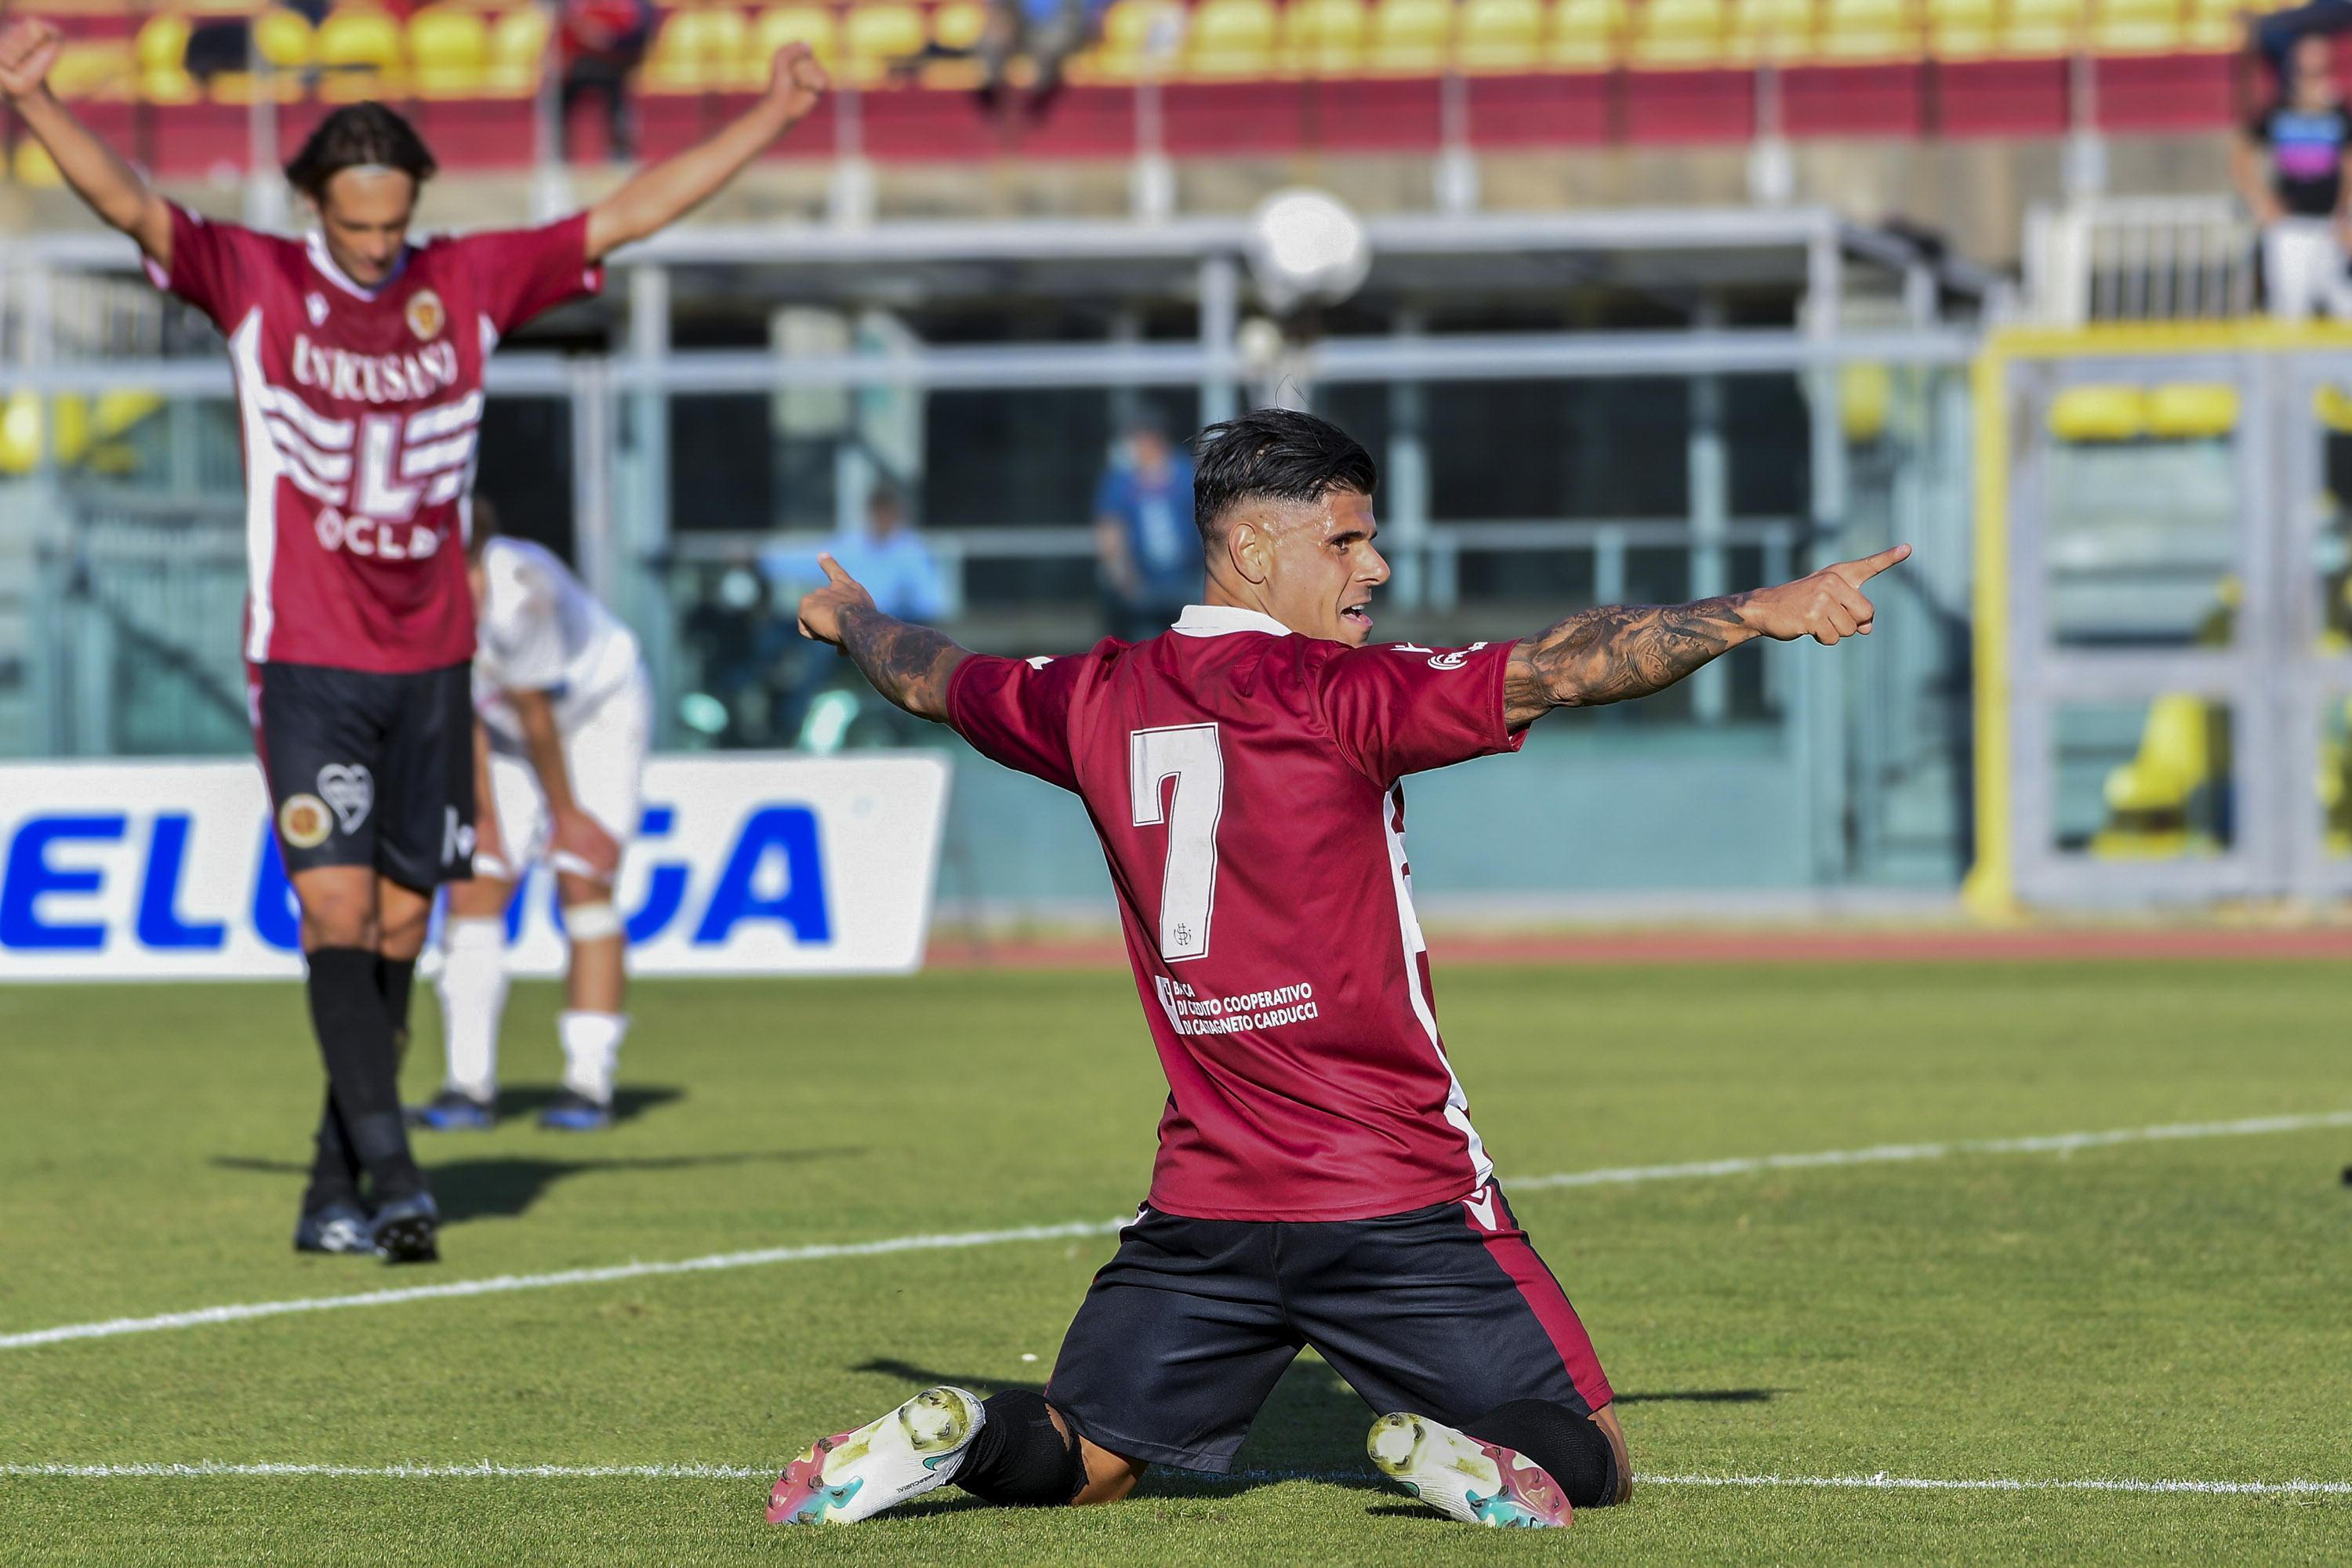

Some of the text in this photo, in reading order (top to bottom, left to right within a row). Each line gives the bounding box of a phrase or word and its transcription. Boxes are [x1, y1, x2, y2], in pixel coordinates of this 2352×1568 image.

[1131, 722, 1224, 963] 7
[1178, 1000, 1189, 1015] DI
[1224, 982, 1312, 1013] COOPERATIVO
[1182, 1020, 1193, 1035] DI
[1254, 1001, 1319, 1029] CARDUCCI
